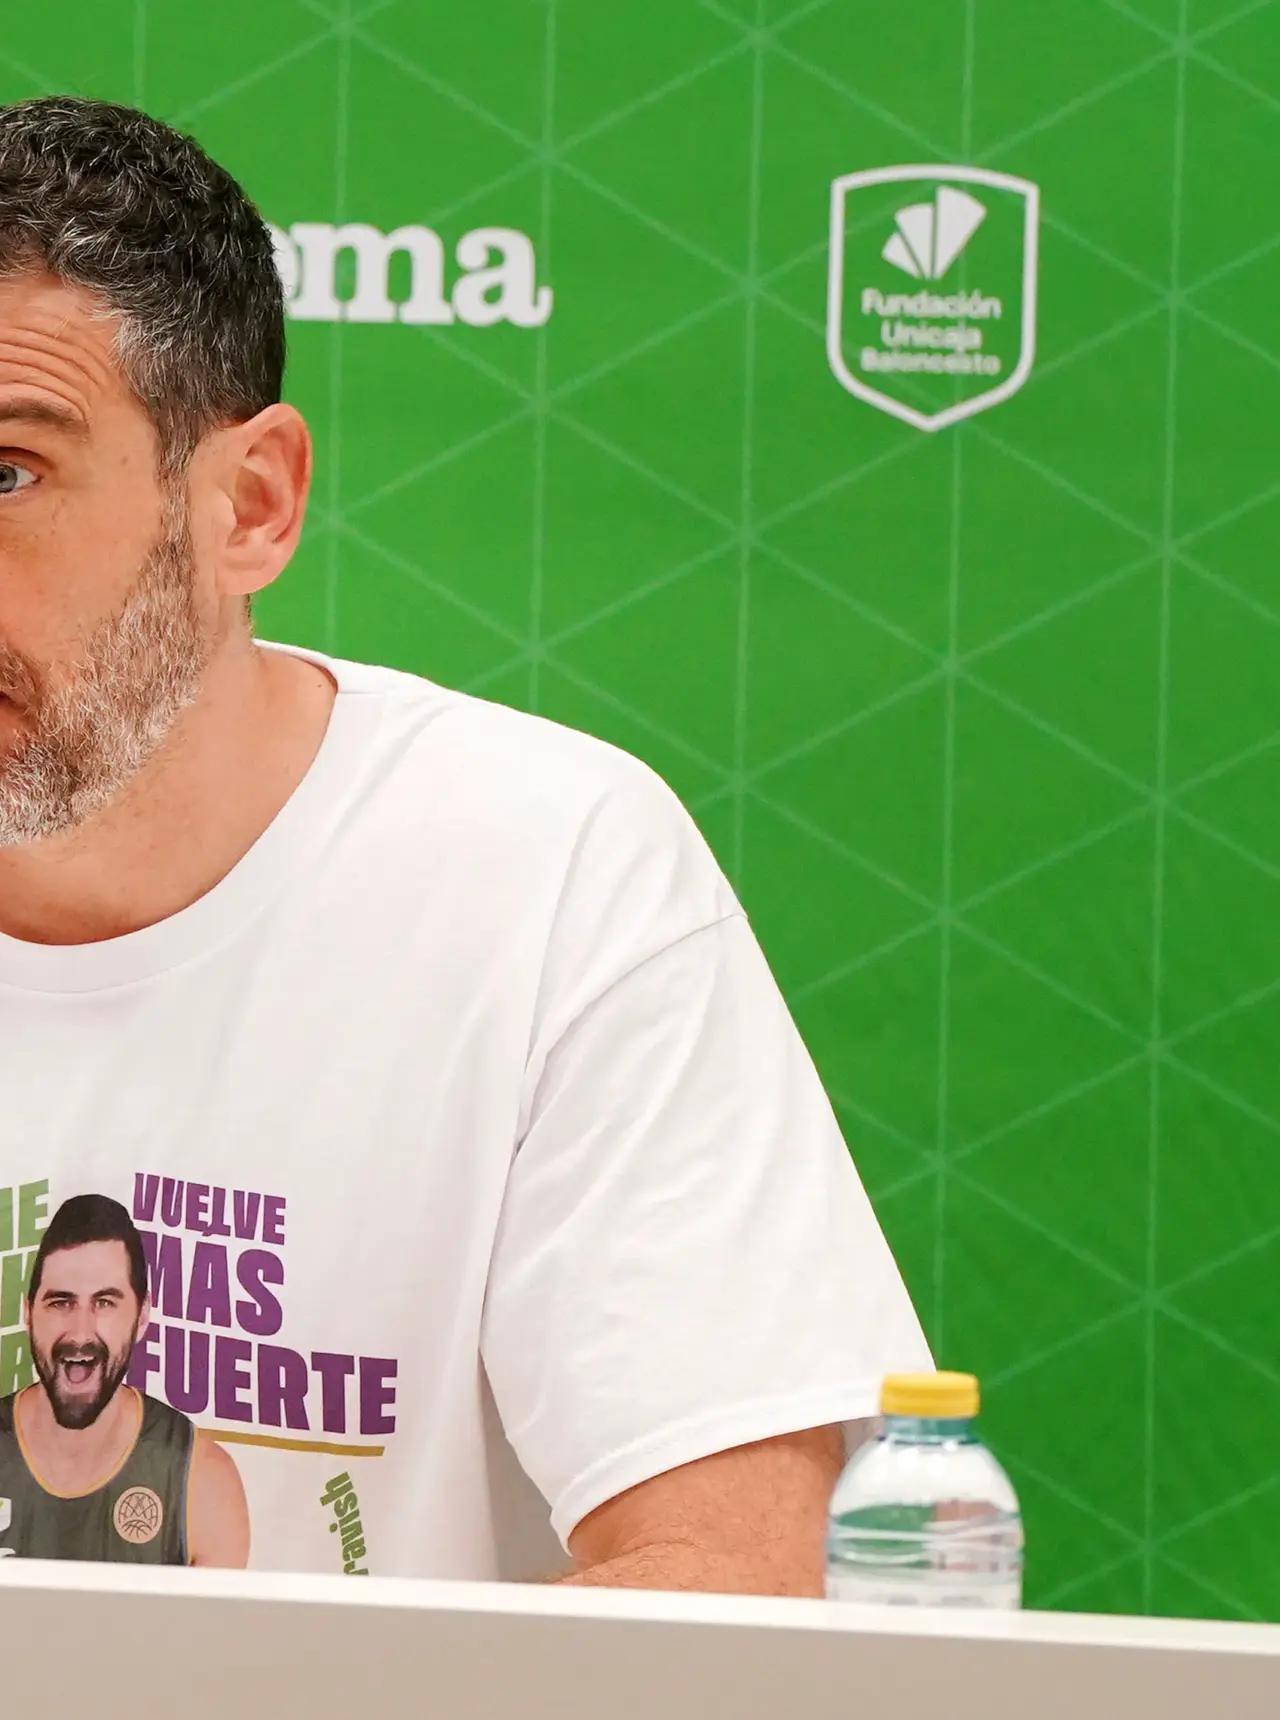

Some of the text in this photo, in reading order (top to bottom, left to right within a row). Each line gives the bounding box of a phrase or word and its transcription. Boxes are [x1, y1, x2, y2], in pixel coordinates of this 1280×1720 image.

[268, 221, 554, 328] ma
[861, 287, 1002, 320] Fundación
[880, 318, 983, 355] Unicaja
[132, 1172, 287, 1246] VUELVE
[125, 1321, 398, 1435] FUERTE
[319, 1470, 370, 1576] ravish
